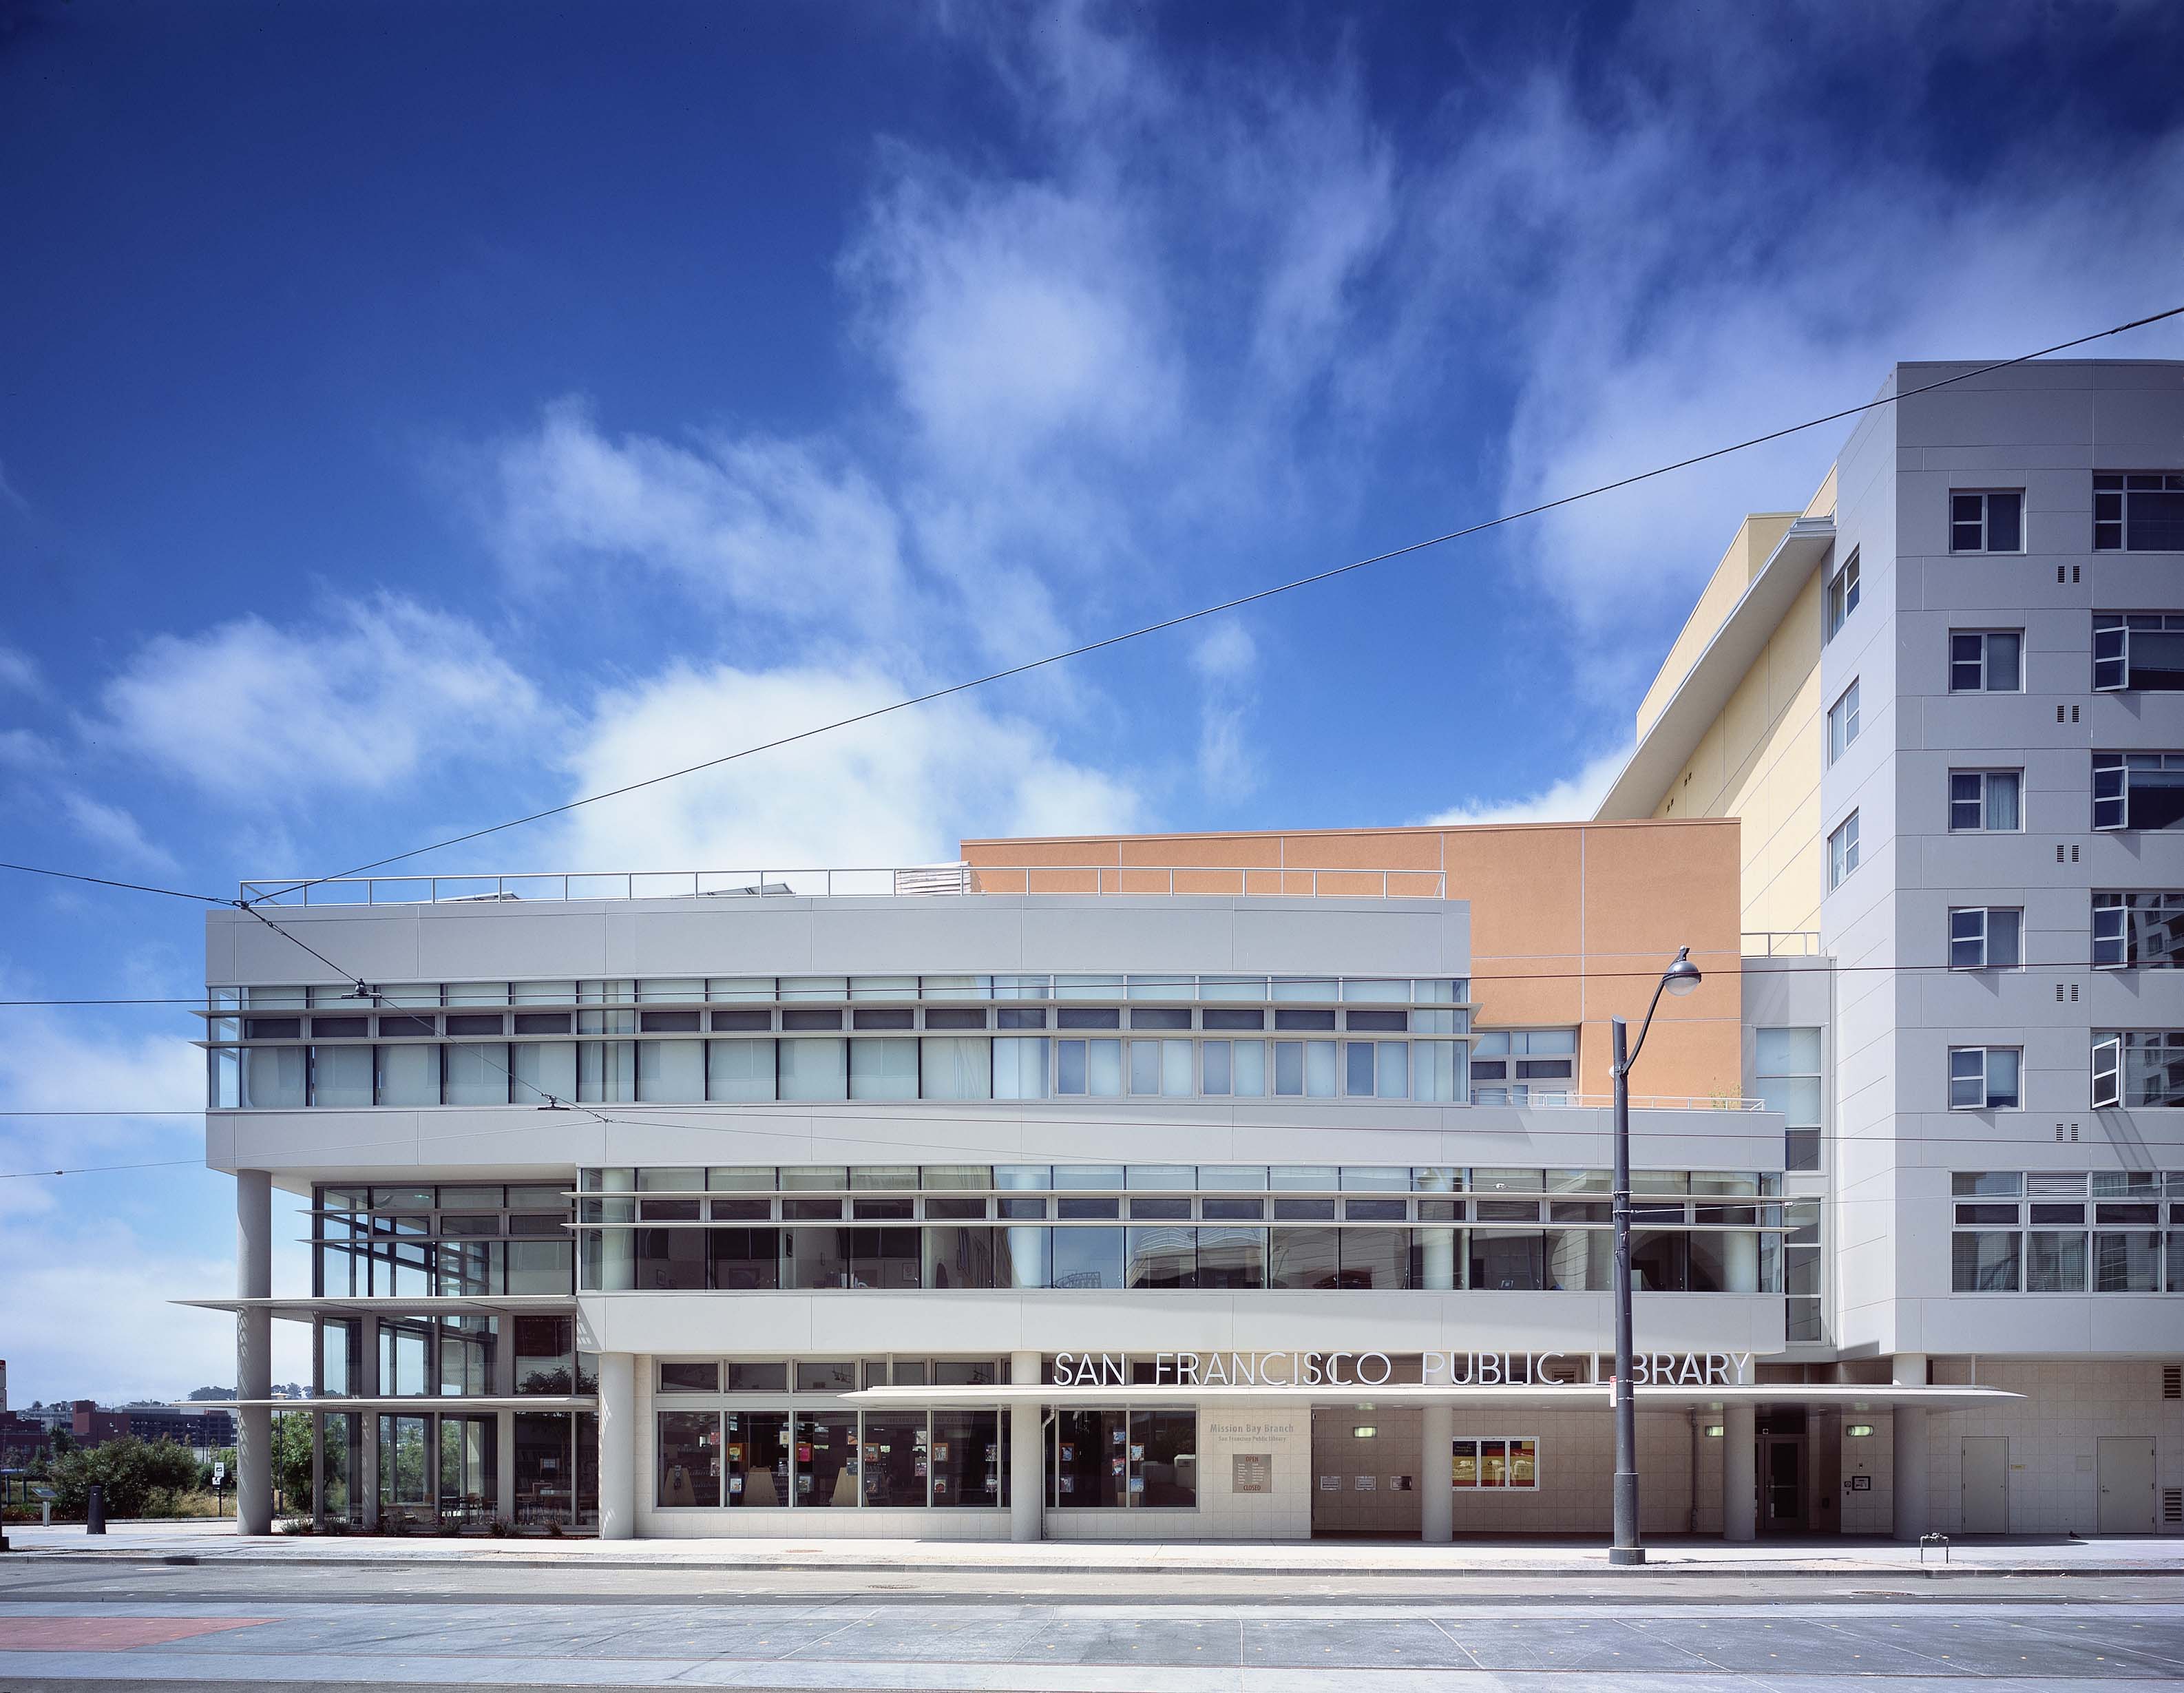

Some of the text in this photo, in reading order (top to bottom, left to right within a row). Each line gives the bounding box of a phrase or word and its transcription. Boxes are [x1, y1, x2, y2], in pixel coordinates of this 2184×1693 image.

[1053, 1351, 1750, 1385] SAN FRANCISCO PUBLIC LBRARY
[1210, 1424, 1294, 1434] Mission Bay Branch
